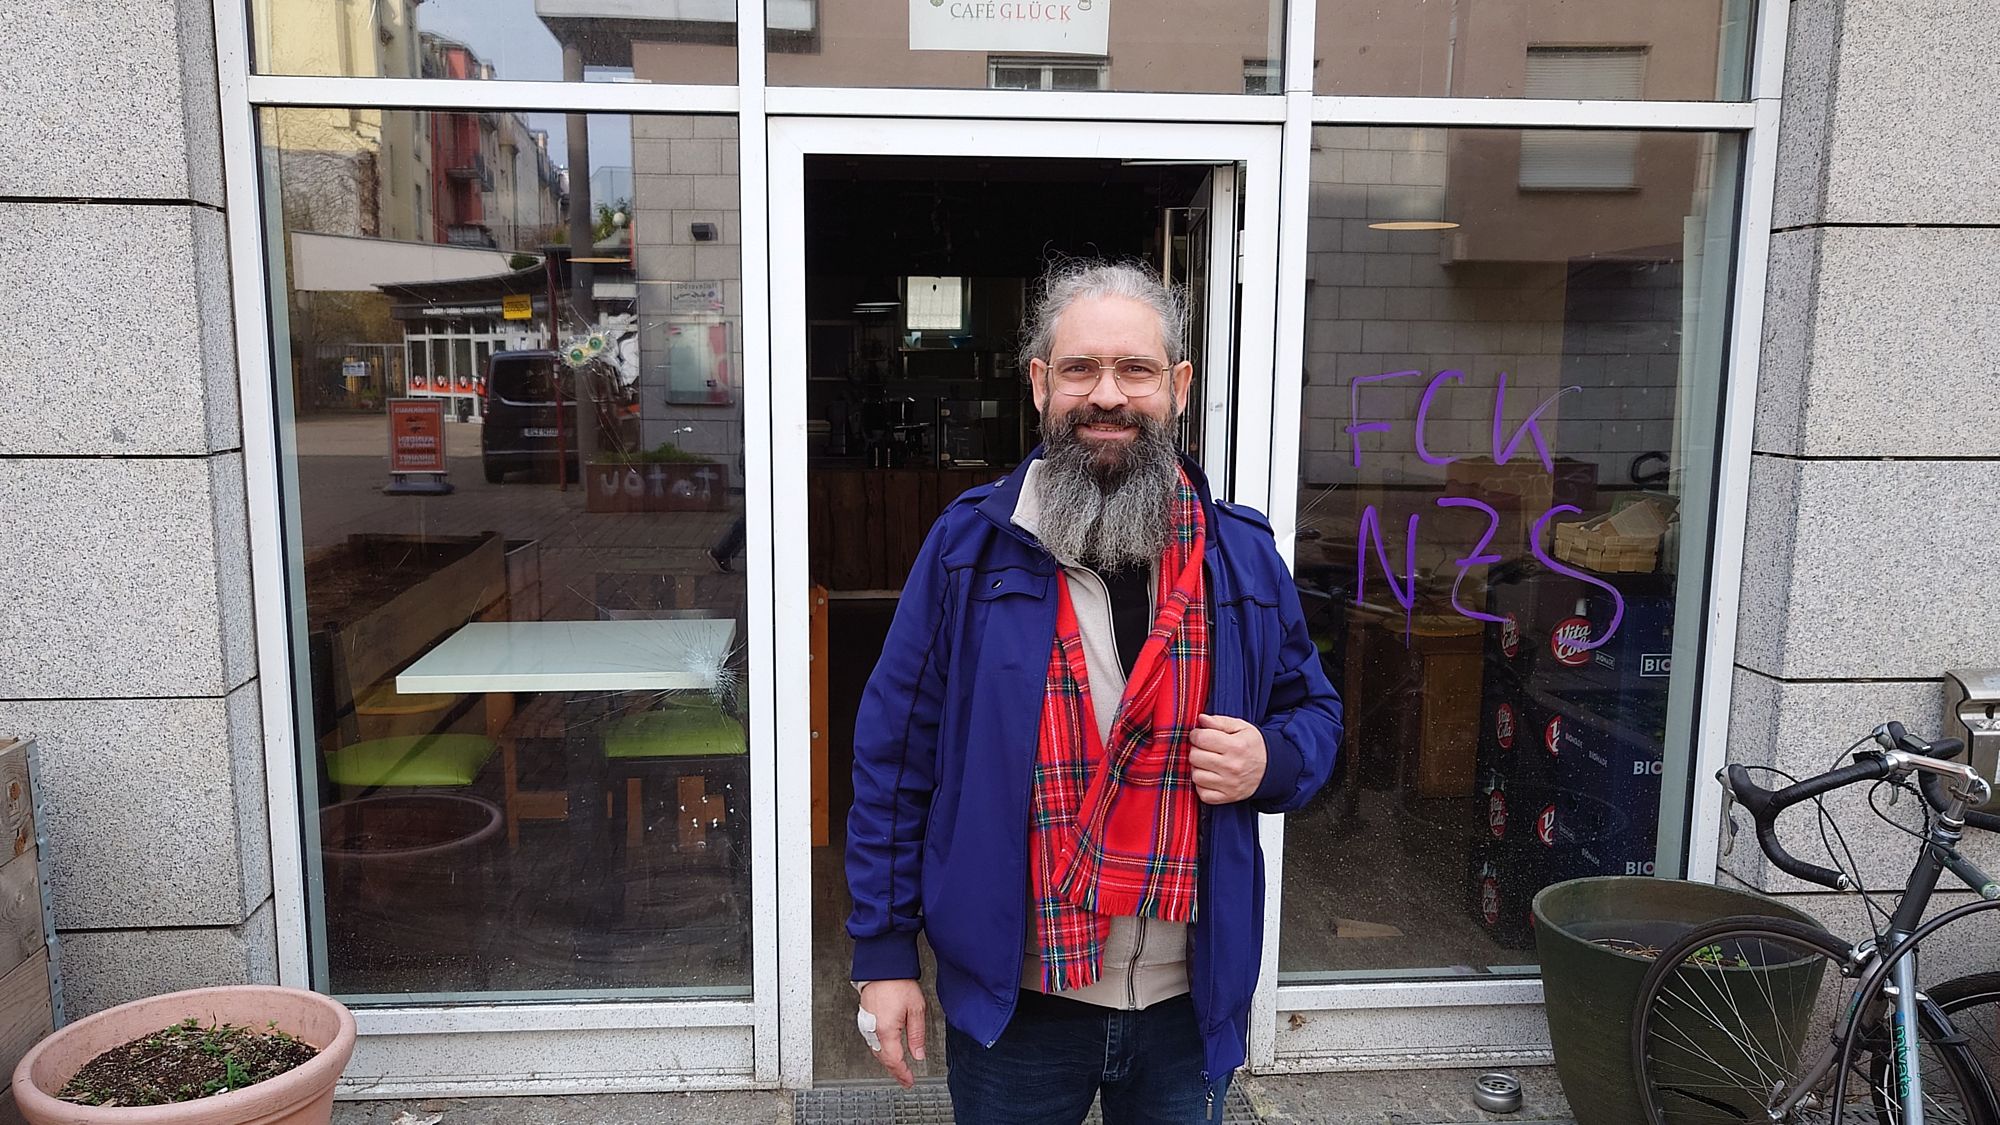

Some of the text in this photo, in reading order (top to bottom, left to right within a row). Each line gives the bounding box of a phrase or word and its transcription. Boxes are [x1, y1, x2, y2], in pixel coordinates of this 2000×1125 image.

[950, 1, 1071, 21] CAFÉ GLÜCK
[1345, 370, 1582, 473] FCK
[1356, 497, 1625, 649] NZS
[1556, 624, 1591, 641] Vita
[1557, 637, 1591, 659] Cola
